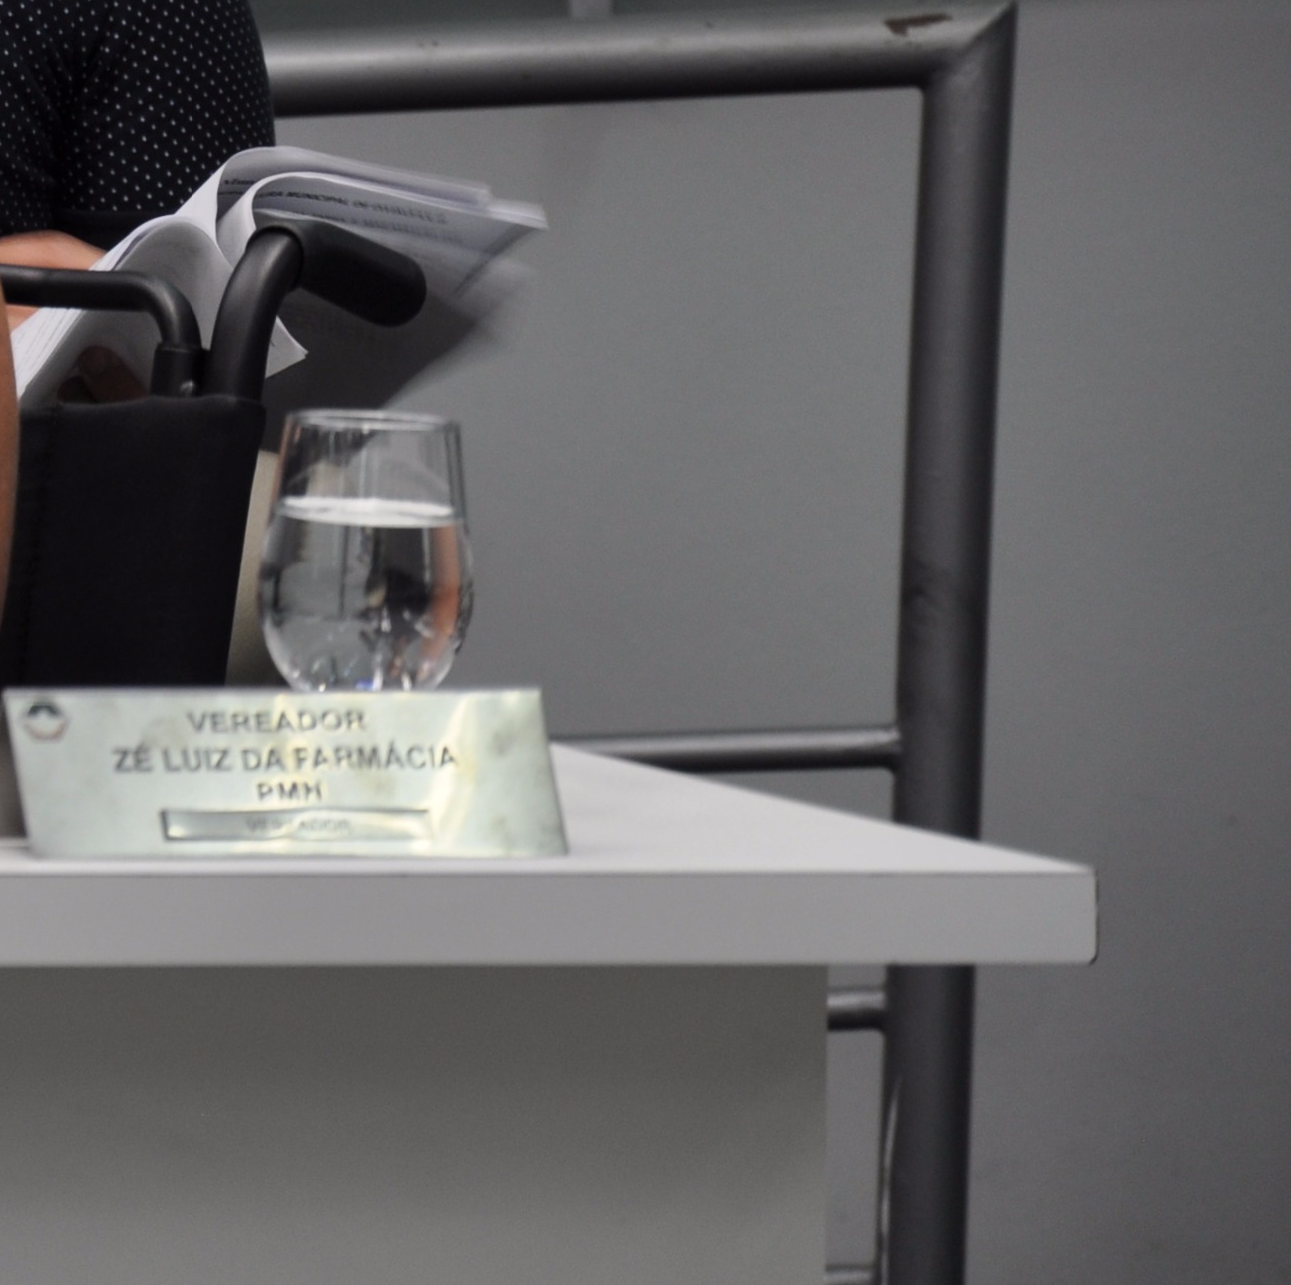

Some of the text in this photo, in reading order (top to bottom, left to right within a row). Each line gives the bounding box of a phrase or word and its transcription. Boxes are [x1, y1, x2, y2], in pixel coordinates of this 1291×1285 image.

[186, 708, 367, 734] VEREADOR
[112, 740, 459, 774] ZÉ LUIZ DA FARMÁCIA
